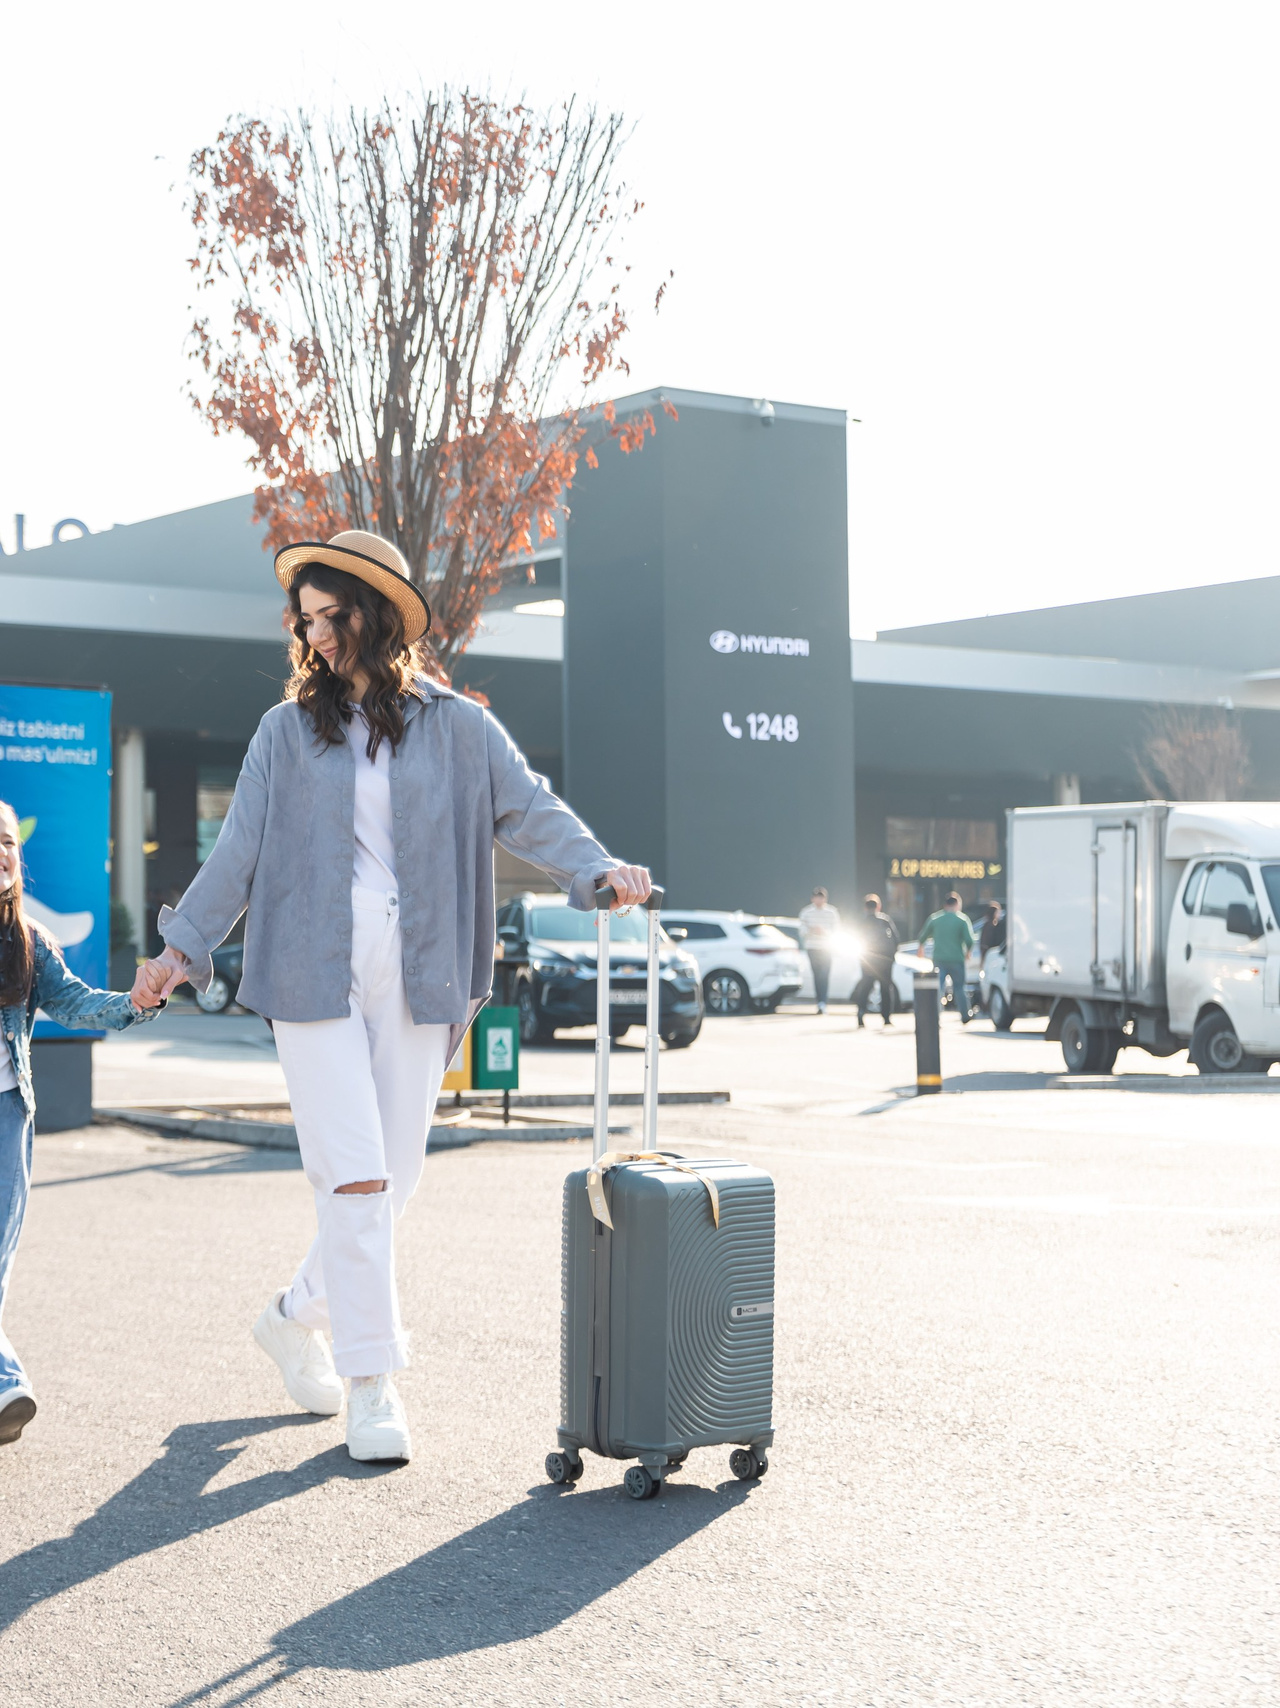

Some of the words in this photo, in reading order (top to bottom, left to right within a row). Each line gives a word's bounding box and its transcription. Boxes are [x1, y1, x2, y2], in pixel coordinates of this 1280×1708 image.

[740, 634, 810, 657] HYUNDAI
[18, 719, 85, 741] tabiatni
[746, 712, 800, 743] 1248
